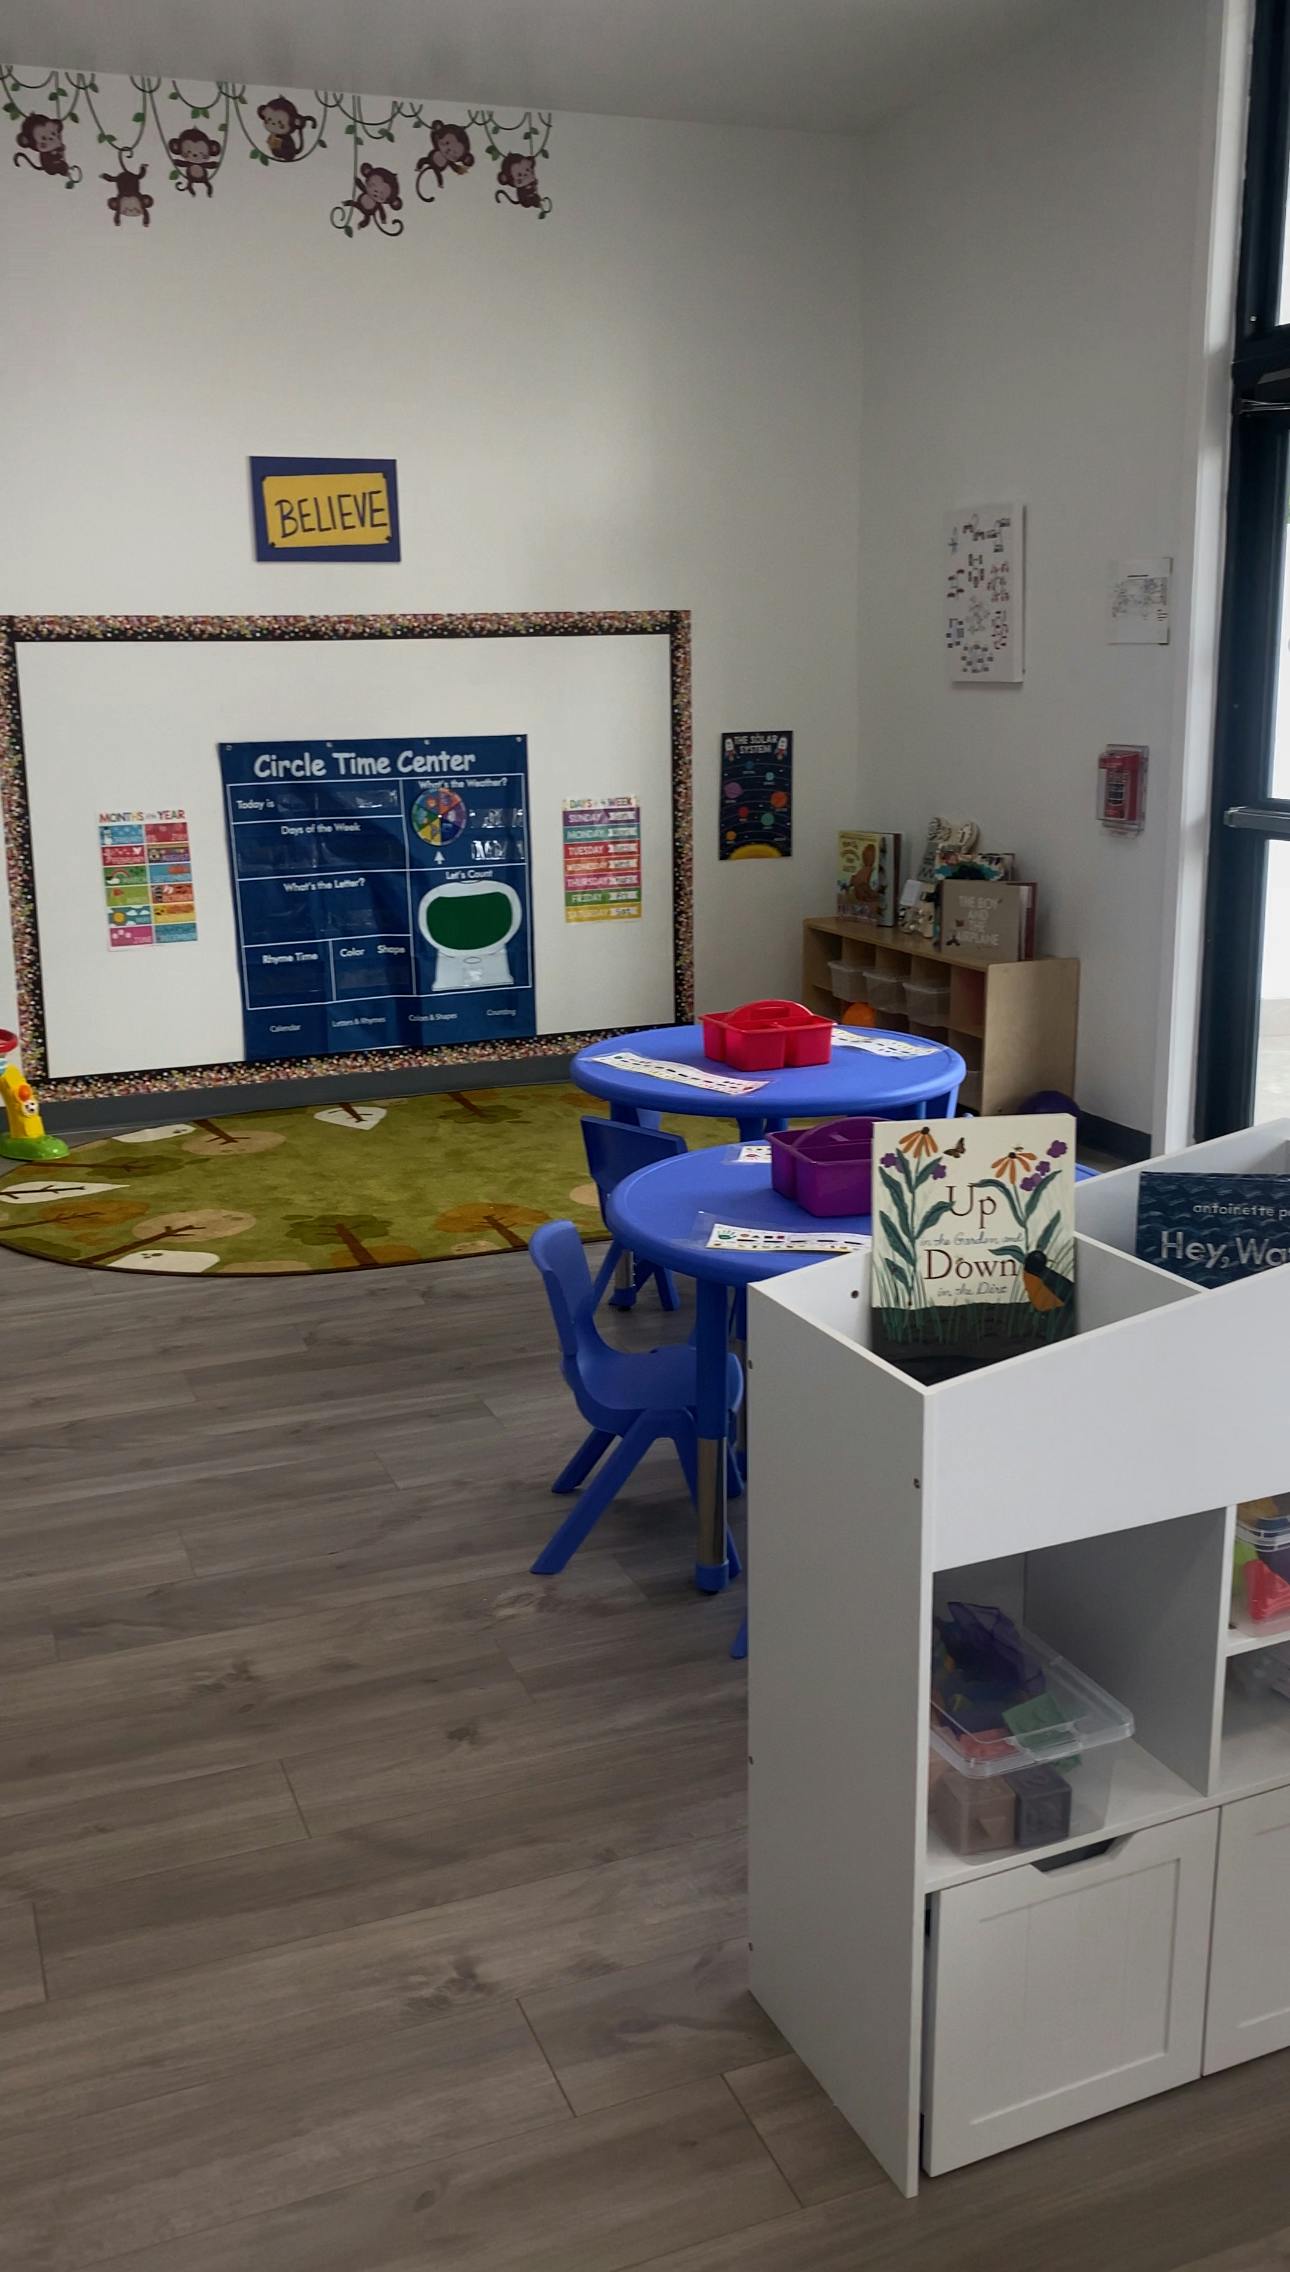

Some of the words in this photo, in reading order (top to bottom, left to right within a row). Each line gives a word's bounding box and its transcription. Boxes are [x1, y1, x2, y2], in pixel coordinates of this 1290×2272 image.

[274, 490, 388, 538] BELIEVE
[734, 735, 748, 744] THE
[750, 735, 778, 744] SOLAR
[740, 745, 772, 754] SYSTEM
[254, 752, 327, 778] Circle
[332, 752, 391, 776] Time
[397, 750, 476, 773] Center
[418, 780, 449, 789] What's
[450, 780, 464, 788] the
[466, 777, 508, 787] Weather?
[236, 799, 264, 810] Today
[266, 799, 275, 808] is
[570, 799, 592, 809] DAYS
[608, 797, 632, 807] WEEK
[99, 812, 144, 823] MONTHS
[157, 810, 186, 821] YEAR
[568, 813, 602, 823] SUNDAY
[281, 825, 304, 836] Days
[305, 824, 315, 833] of
[316, 823, 333, 833] the
[334, 822, 361, 832] Week
[567, 829, 604, 839] MONDAY
[568, 846, 604, 855] TUESDAY
[445, 871, 466, 880] Let's
[467, 870, 493, 879] Count
[283, 881, 316, 892] What's
[317, 880, 332, 890] the
[334, 877, 366, 889] Letter?
[572, 893, 602, 902] FRIDAY
[958, 896, 976, 908] THE
[977, 897, 998, 909] BOY
[968, 909, 989, 920] AND
[339, 947, 365, 957] Color
[377, 944, 406, 955] Shape
[262, 954, 293, 965] Rhyme
[294, 952, 318, 961] Time
[331, 1018, 353, 1027] Letters
[354, 1017, 359, 1025] &
[360, 1016, 387, 1025] Rhymes
[435, 1013, 458, 1021] Shapes
[269, 1024, 302, 1033] Calendar
[946, 1183, 997, 1229] Up
[1192, 1202, 1275, 1216] antoinette
[920, 1236, 932, 1247] in
[933, 1234, 950, 1247] the
[952, 1231, 999, 1247] Garden
[1001, 1230, 1025, 1244] and
[1161, 1231, 1231, 1269] Hey,
[1235, 1237, 1290, 1267] Wa
[924, 1249, 1019, 1280] Down
[937, 1286, 951, 1297] in
[953, 1283, 973, 1297] the
[976, 1281, 1007, 1295] Dirt
